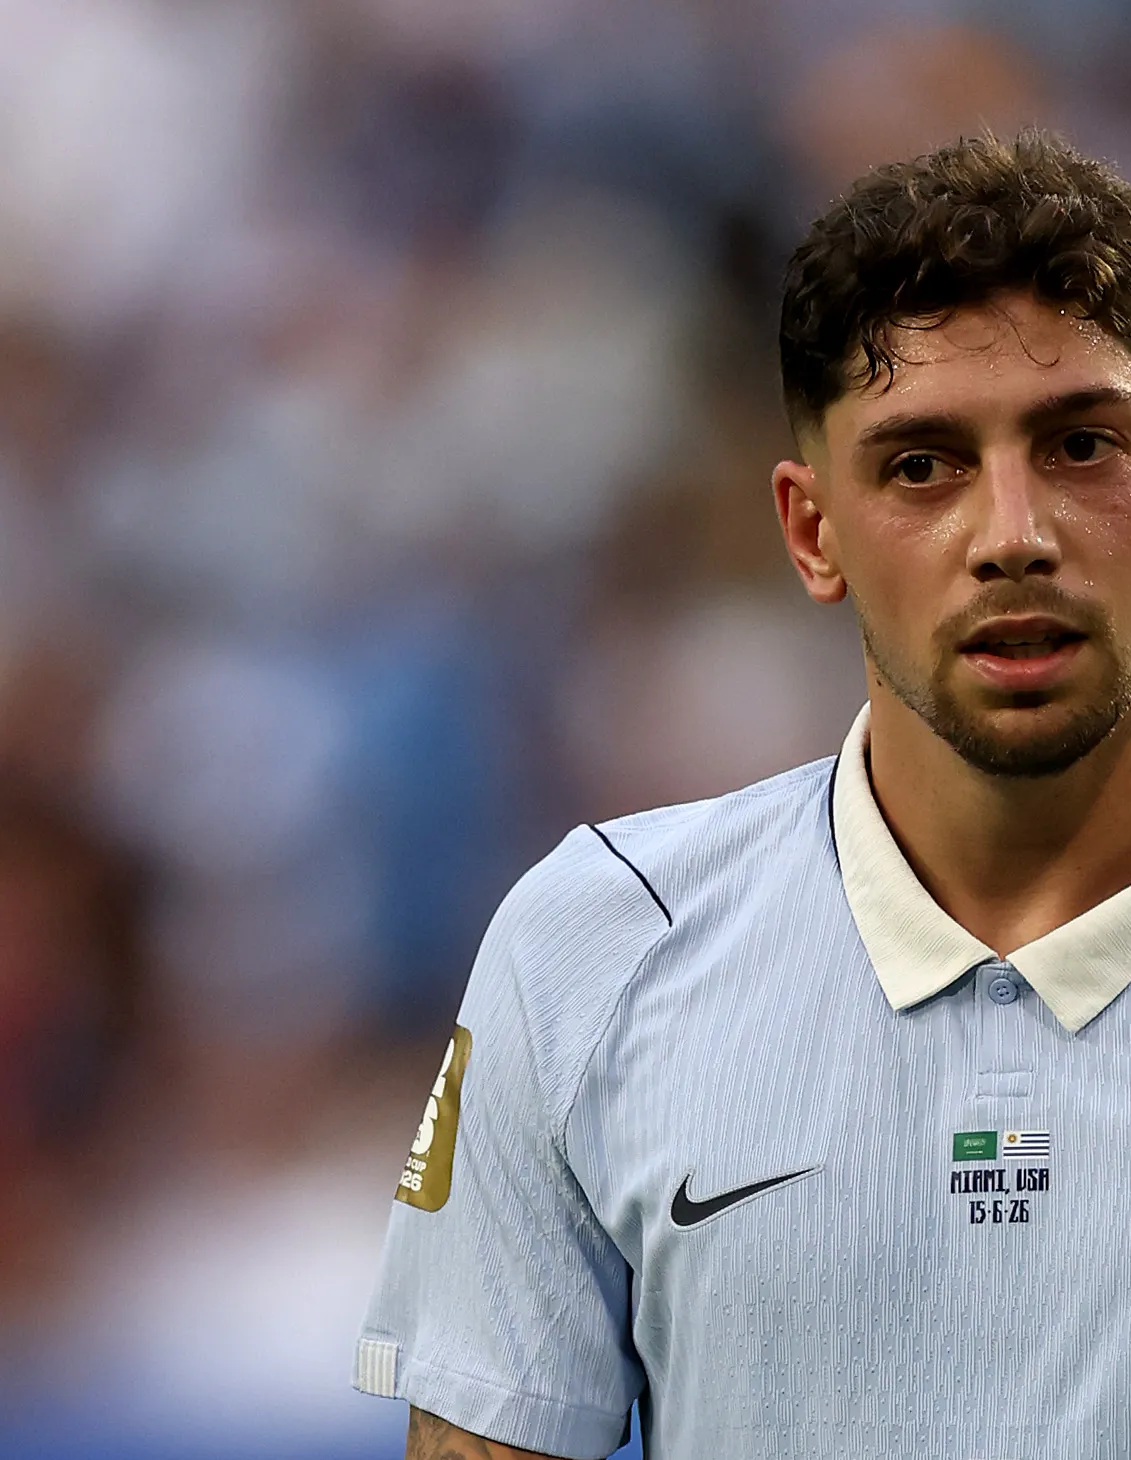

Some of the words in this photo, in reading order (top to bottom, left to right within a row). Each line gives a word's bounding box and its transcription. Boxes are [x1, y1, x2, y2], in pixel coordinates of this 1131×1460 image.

[410, 1158, 427, 1172] CUP
[400, 1170, 423, 1192] 26
[950, 1169, 1010, 1195] MIAMI,
[1016, 1168, 1050, 1192] USA
